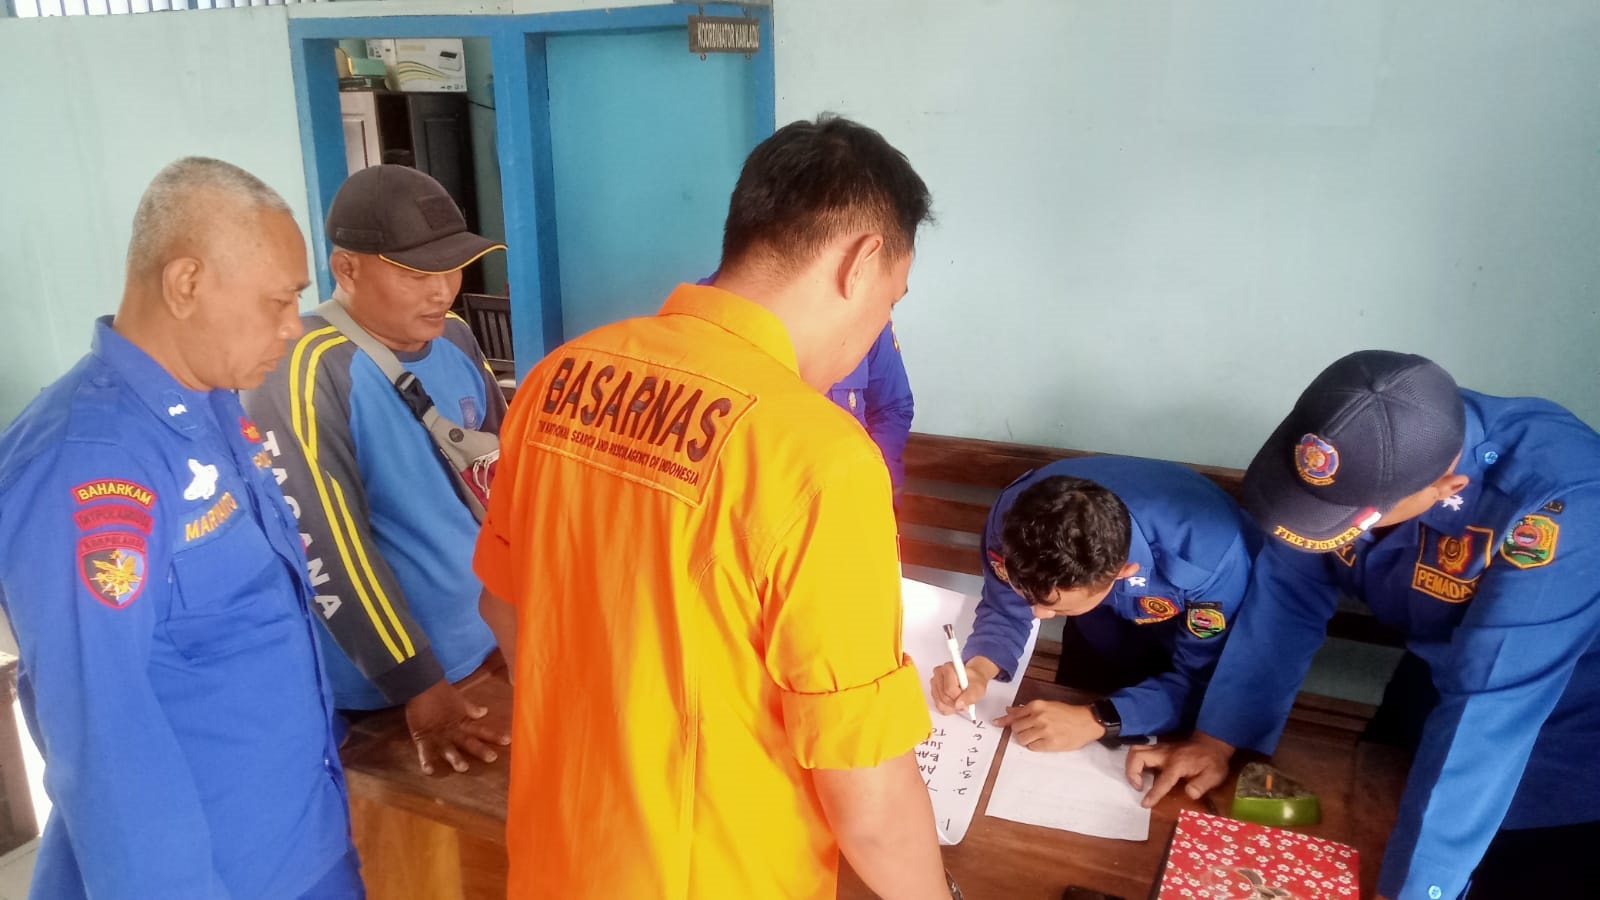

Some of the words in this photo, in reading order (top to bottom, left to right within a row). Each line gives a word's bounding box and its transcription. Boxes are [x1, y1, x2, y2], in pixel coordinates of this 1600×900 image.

[697, 22, 735, 48] KOORDINATOR
[542, 357, 732, 463] BASARNAS
[570, 429, 597, 449] SEARCH
[594, 438, 610, 453] AND
[627, 447, 651, 467] AGENCY
[649, 455, 661, 470] OF
[657, 458, 700, 487] INDONESIA
[77, 482, 152, 505] BAHARKAM
[1274, 525, 1305, 547] FIRE
[1304, 526, 1362, 550] FIGHTER
[1417, 569, 1476, 599] PEMADA
